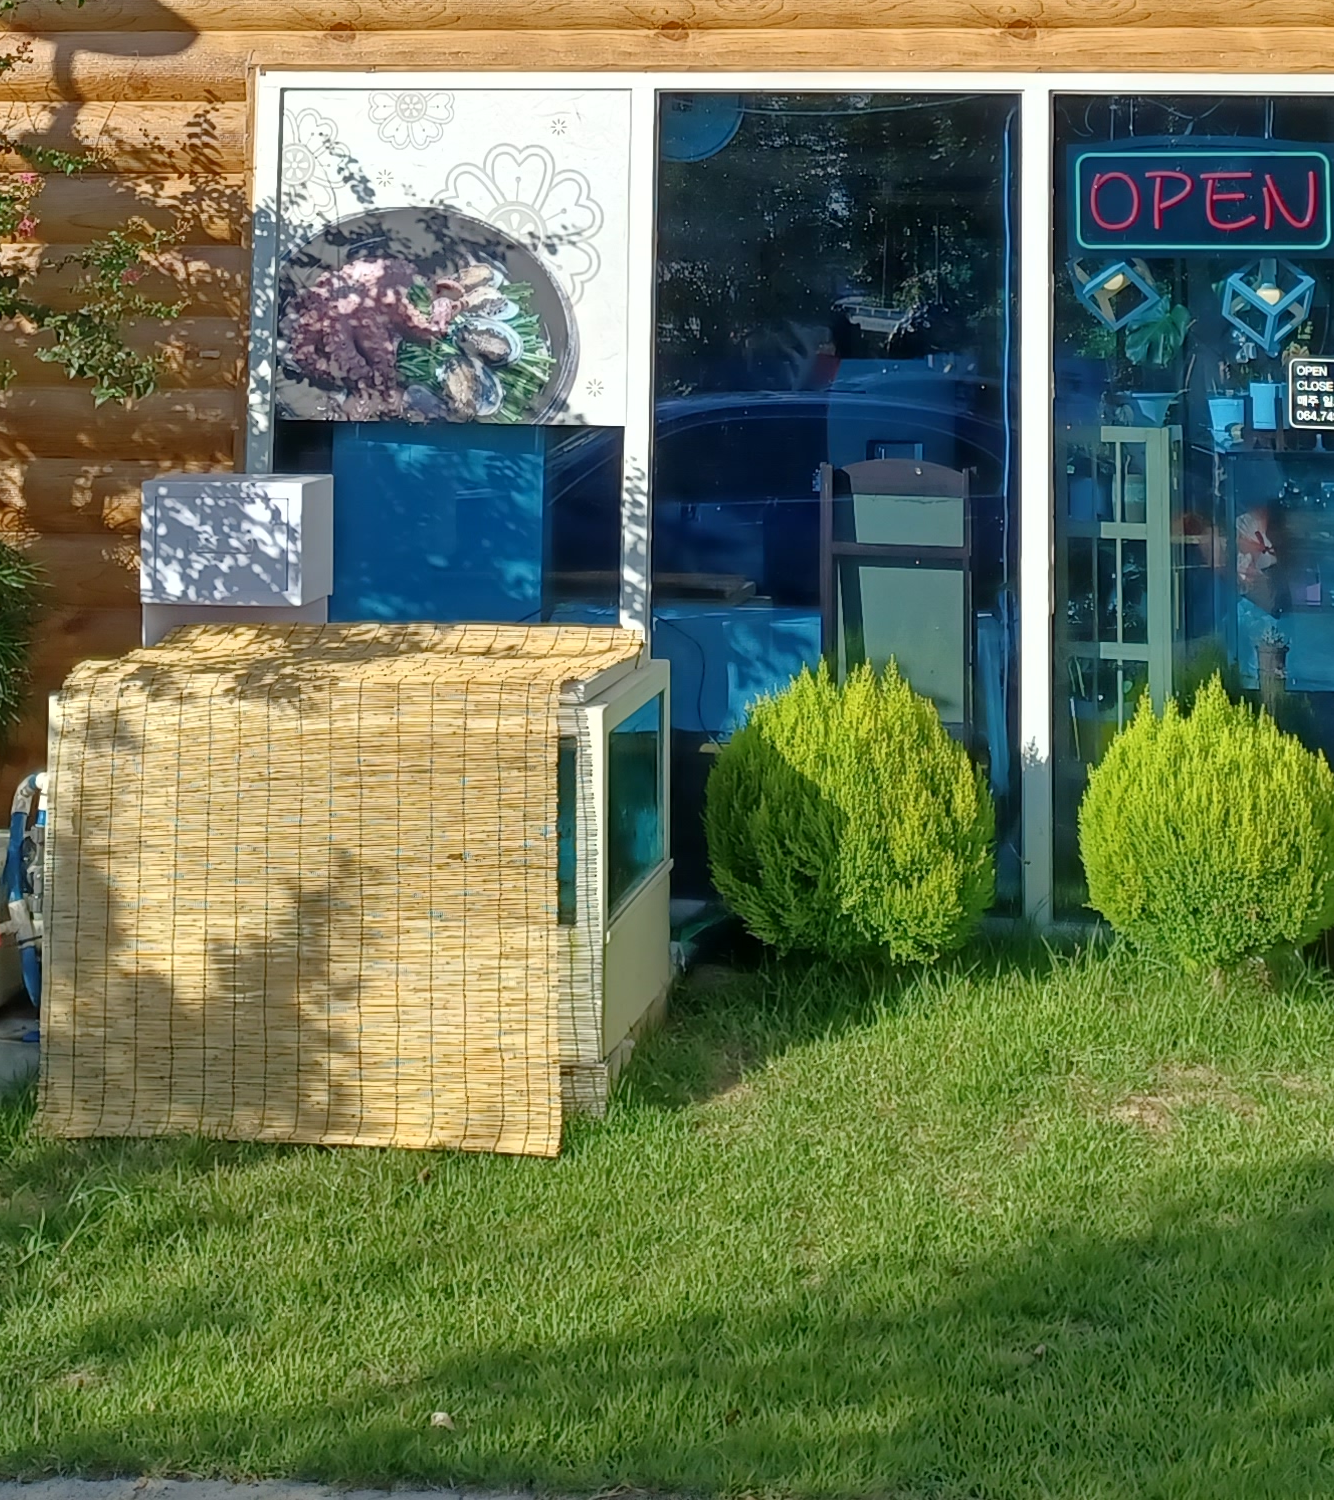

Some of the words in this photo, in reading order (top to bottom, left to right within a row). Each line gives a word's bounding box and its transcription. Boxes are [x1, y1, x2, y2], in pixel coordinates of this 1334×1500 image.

[1089, 170, 1320, 231] OPEN
[1296, 365, 1328, 377] OPEN
[1296, 381, 1334, 392] CLOSE
[1296, 396, 1319, 408] 매주
